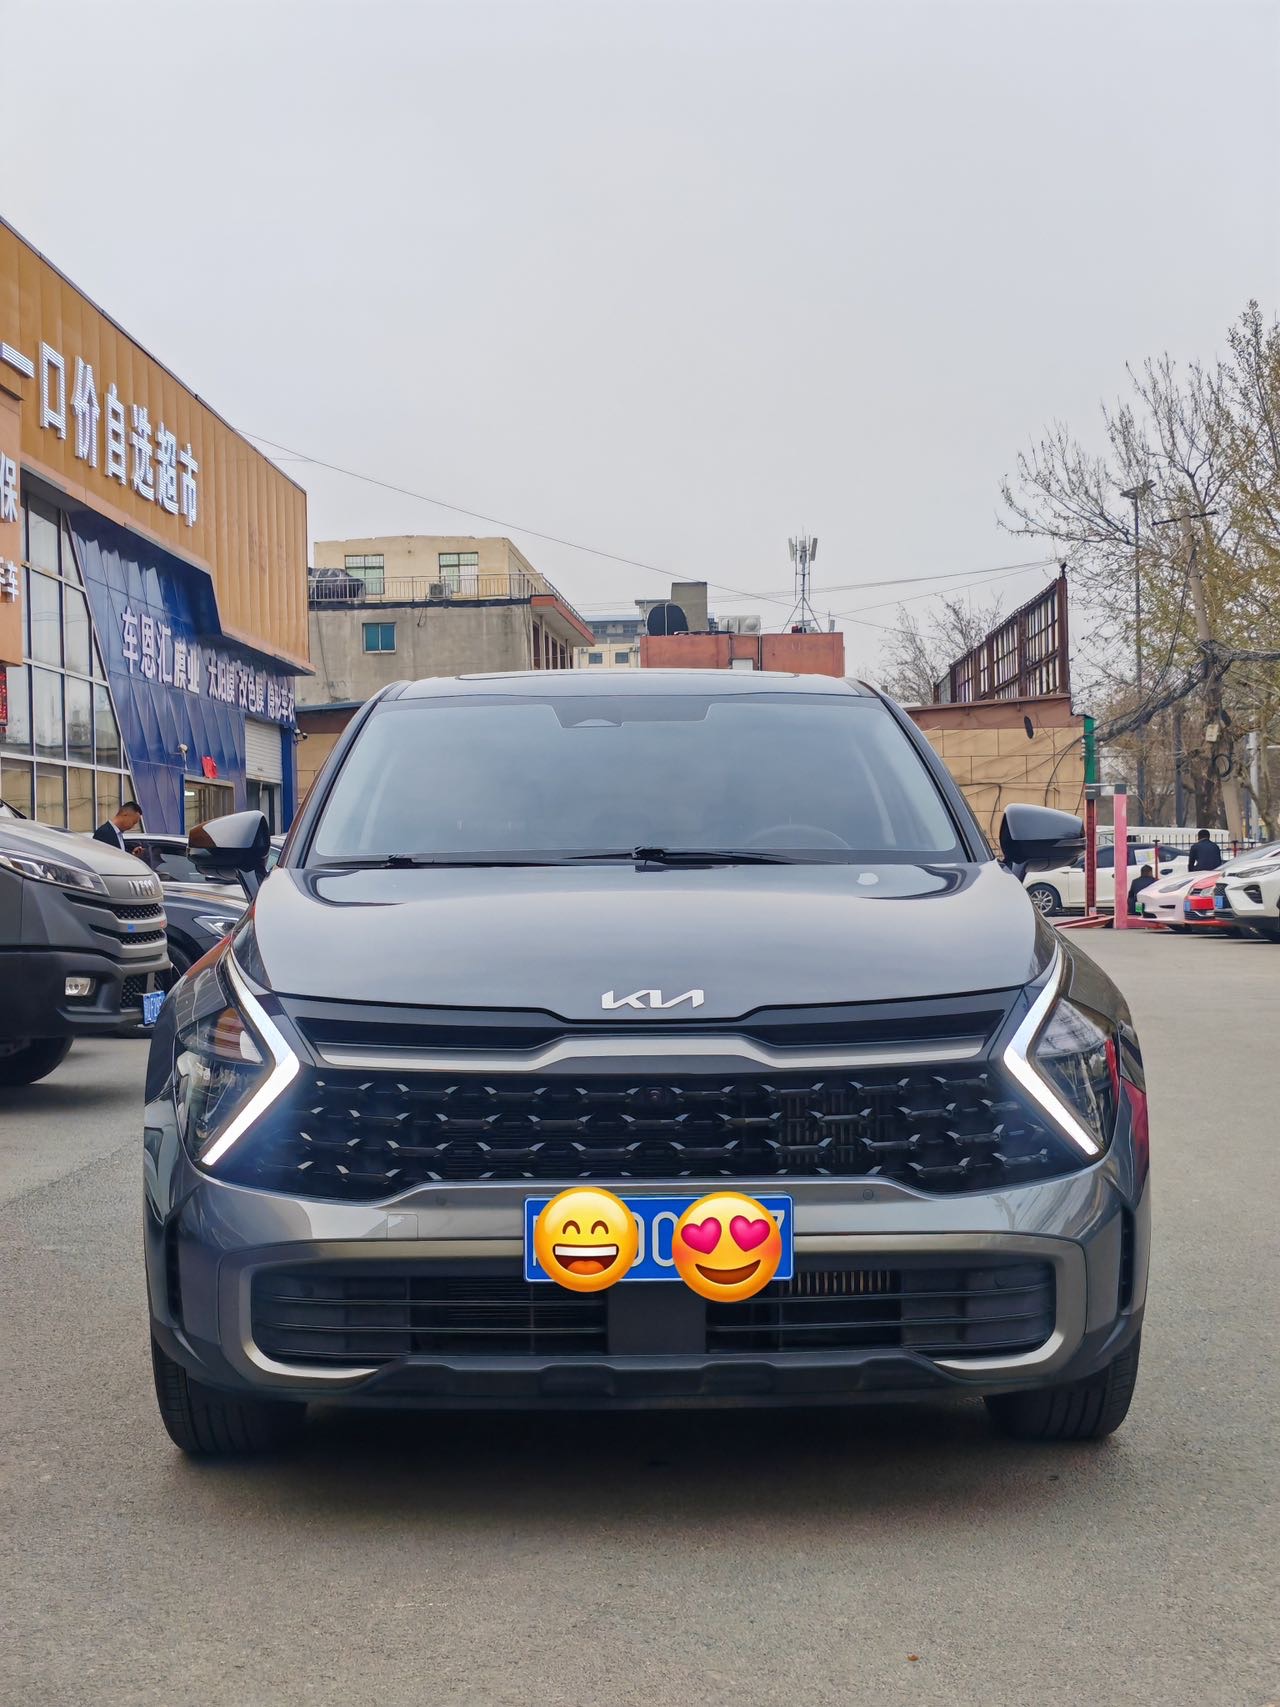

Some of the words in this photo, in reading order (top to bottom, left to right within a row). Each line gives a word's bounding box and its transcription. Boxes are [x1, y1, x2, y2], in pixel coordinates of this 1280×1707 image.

[1, 341, 199, 528] 一口价自选超市
[121, 606, 200, 694] 车恩汇膜业
[602, 989, 705, 1010] KIA
